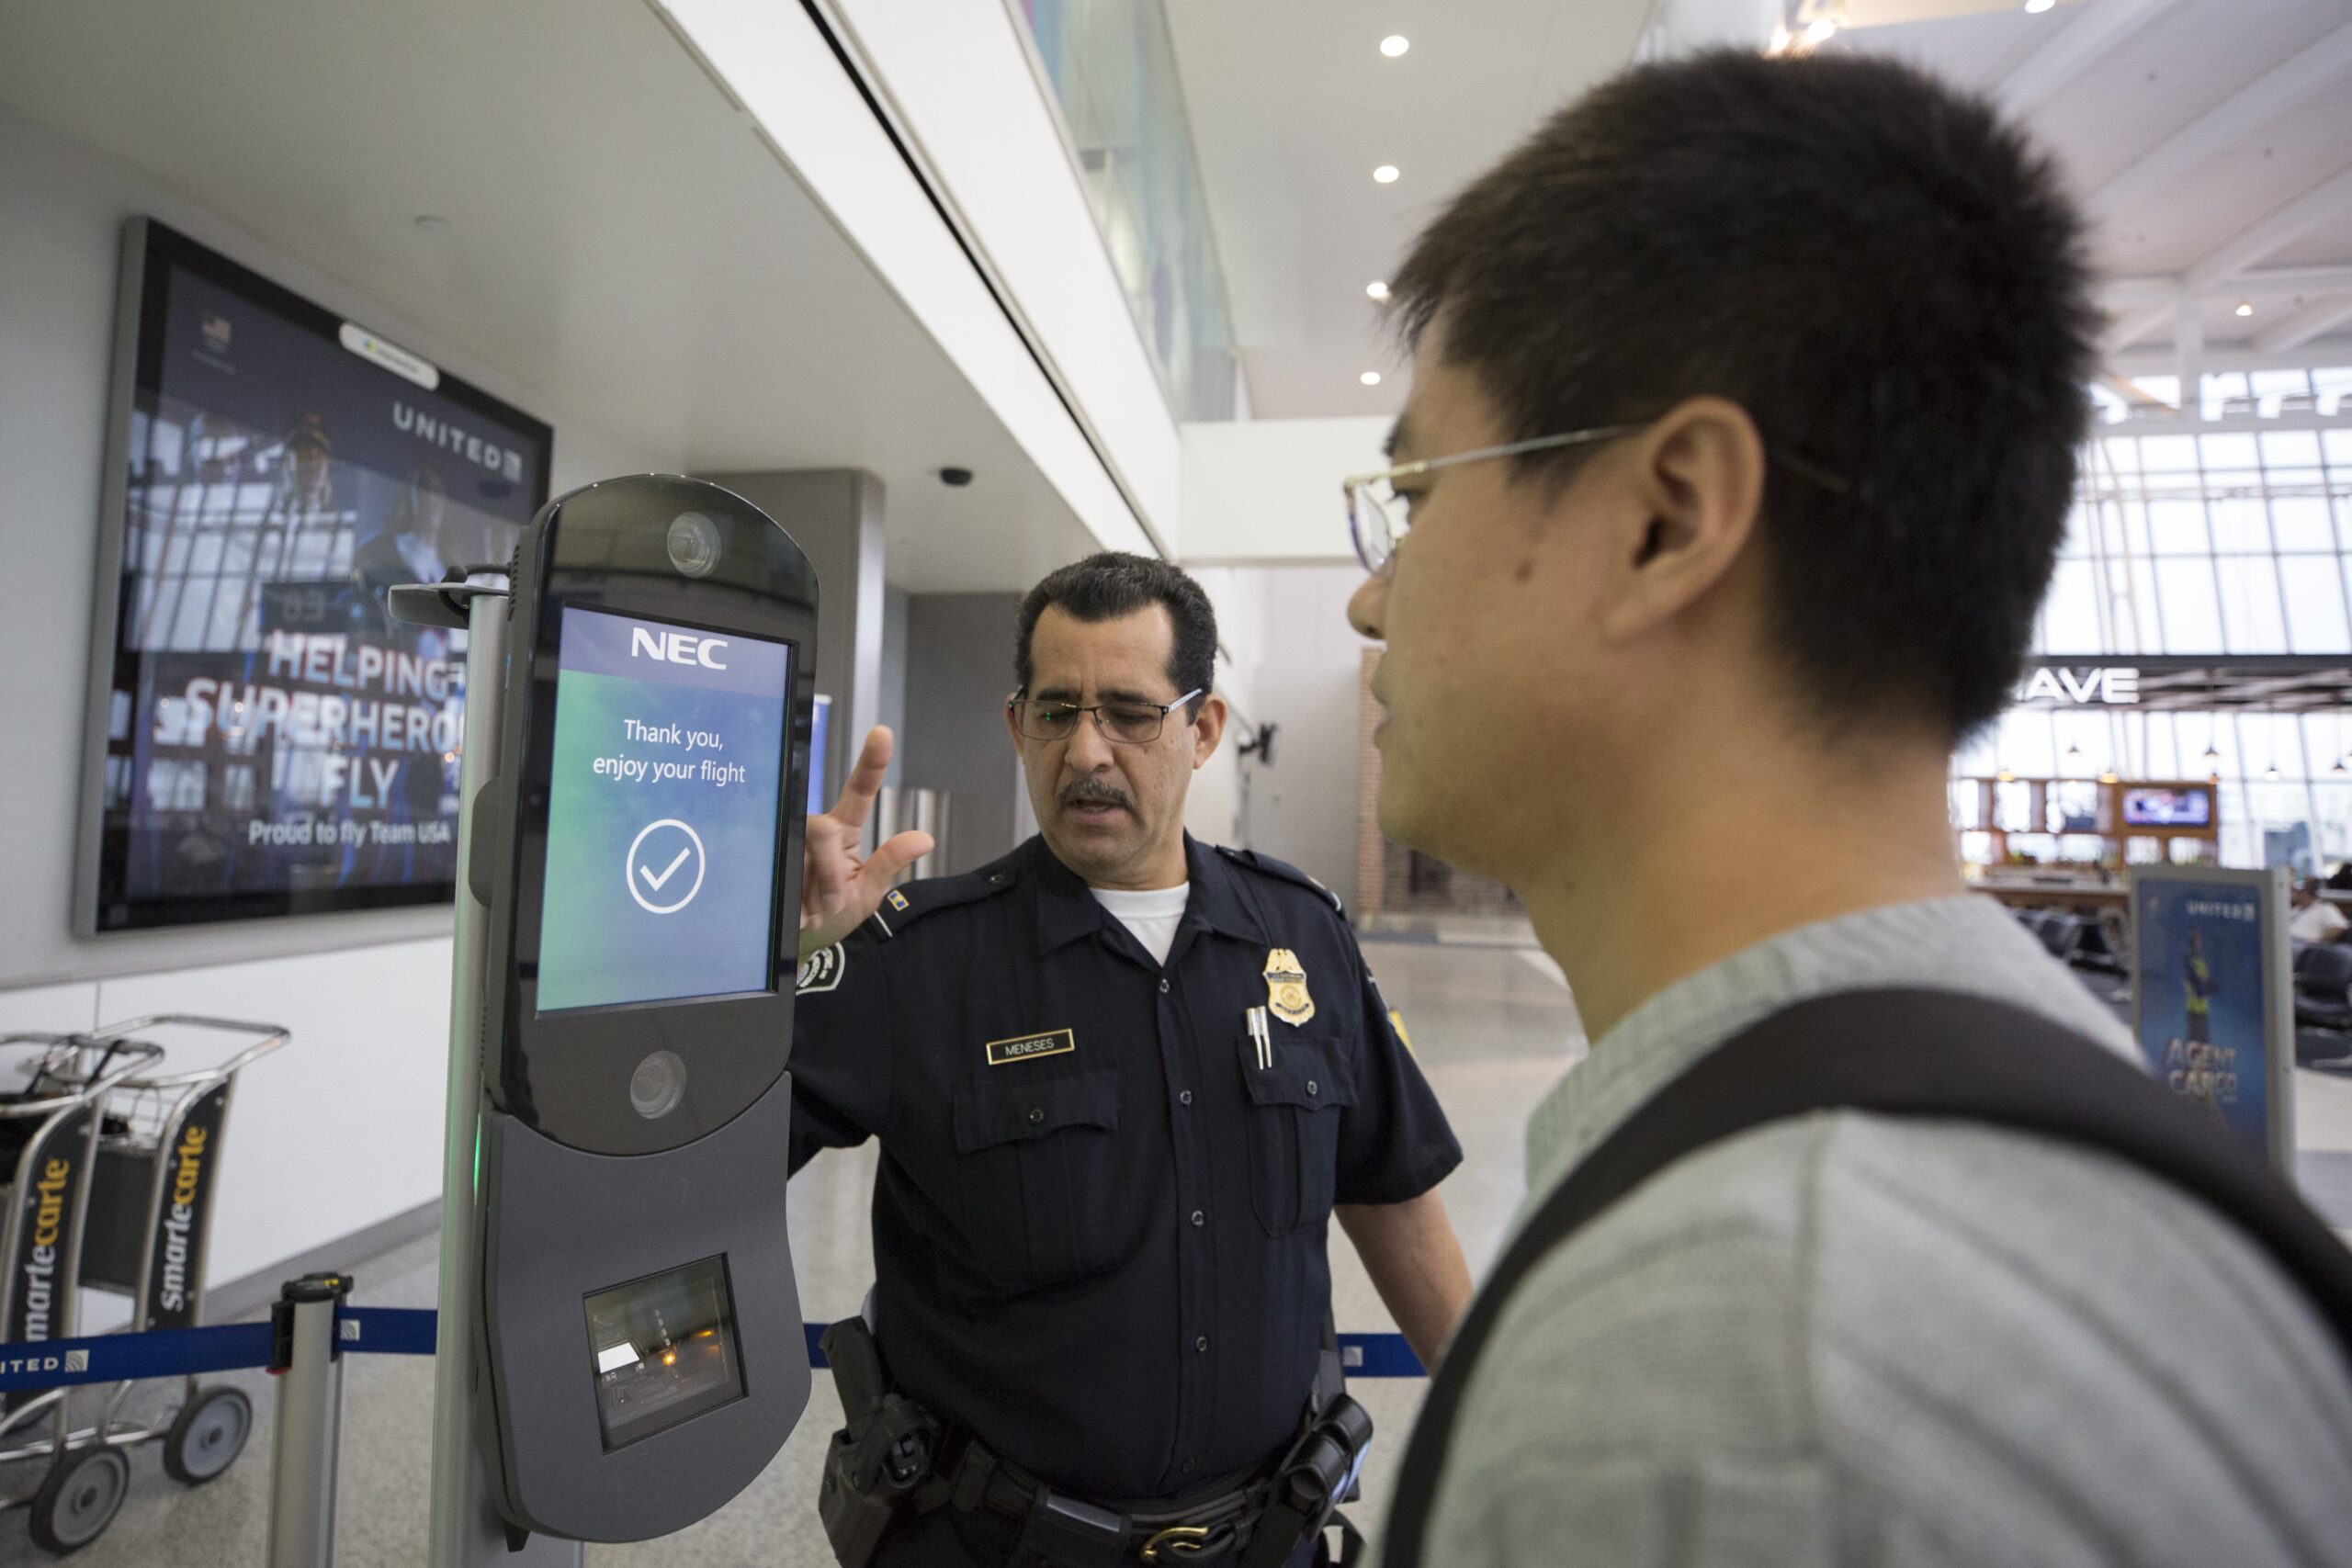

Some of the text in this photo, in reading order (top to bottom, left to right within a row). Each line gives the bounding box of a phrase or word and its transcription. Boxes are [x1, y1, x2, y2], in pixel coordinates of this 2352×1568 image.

[393, 400, 502, 470] UNITED
[269, 629, 449, 702] HELPING
[631, 626, 729, 671] NEC
[2016, 667, 2141, 705] AVE
[185, 677, 465, 756] SUPERHERO
[624, 718, 723, 751] Thank you,
[320, 753, 400, 809] FLY
[593, 753, 745, 787] enjoy your flight
[248, 818, 451, 849] Proud to fly Team USA
[1004, 1038, 1055, 1056] MENESES
[160, 1125, 208, 1313] smartecarte
[24, 1157, 70, 1342] martecarte
[0, 1357, 59, 1374] ITED
